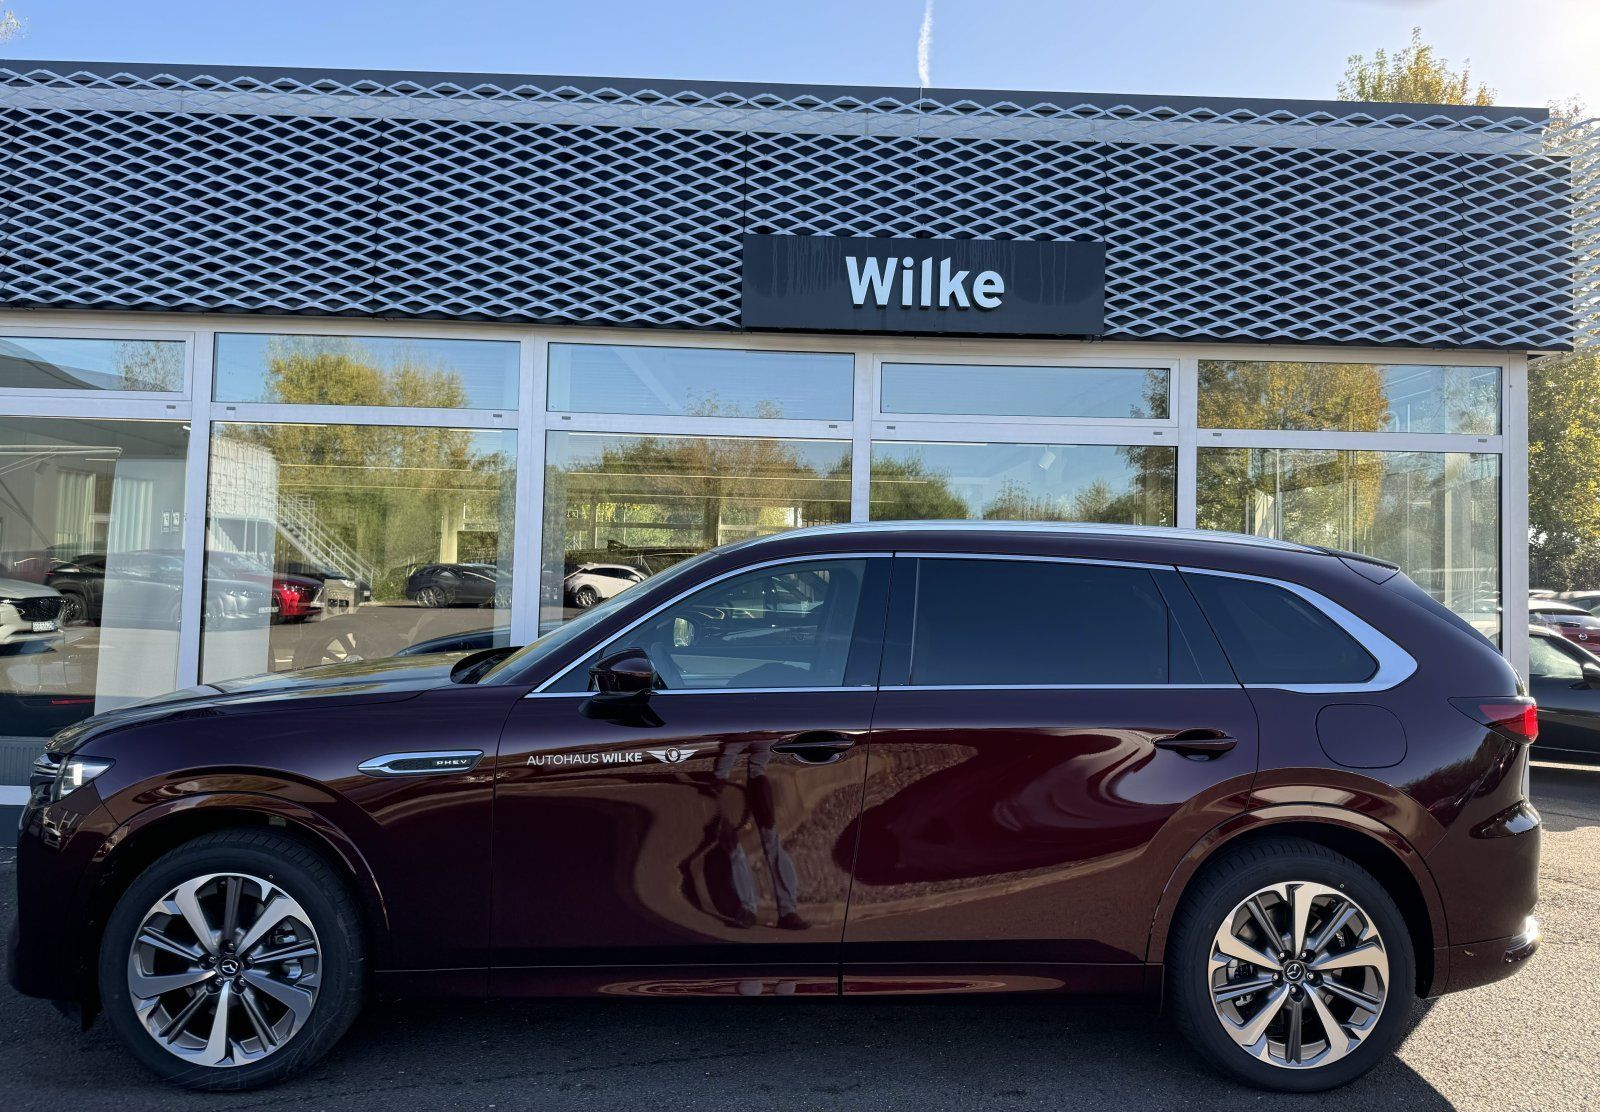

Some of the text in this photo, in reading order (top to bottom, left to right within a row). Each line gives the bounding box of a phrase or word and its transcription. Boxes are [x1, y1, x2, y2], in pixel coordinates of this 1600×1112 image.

[845, 256, 1005, 308] Wilke
[526, 752, 643, 766] AUTOHAUS WILKE
